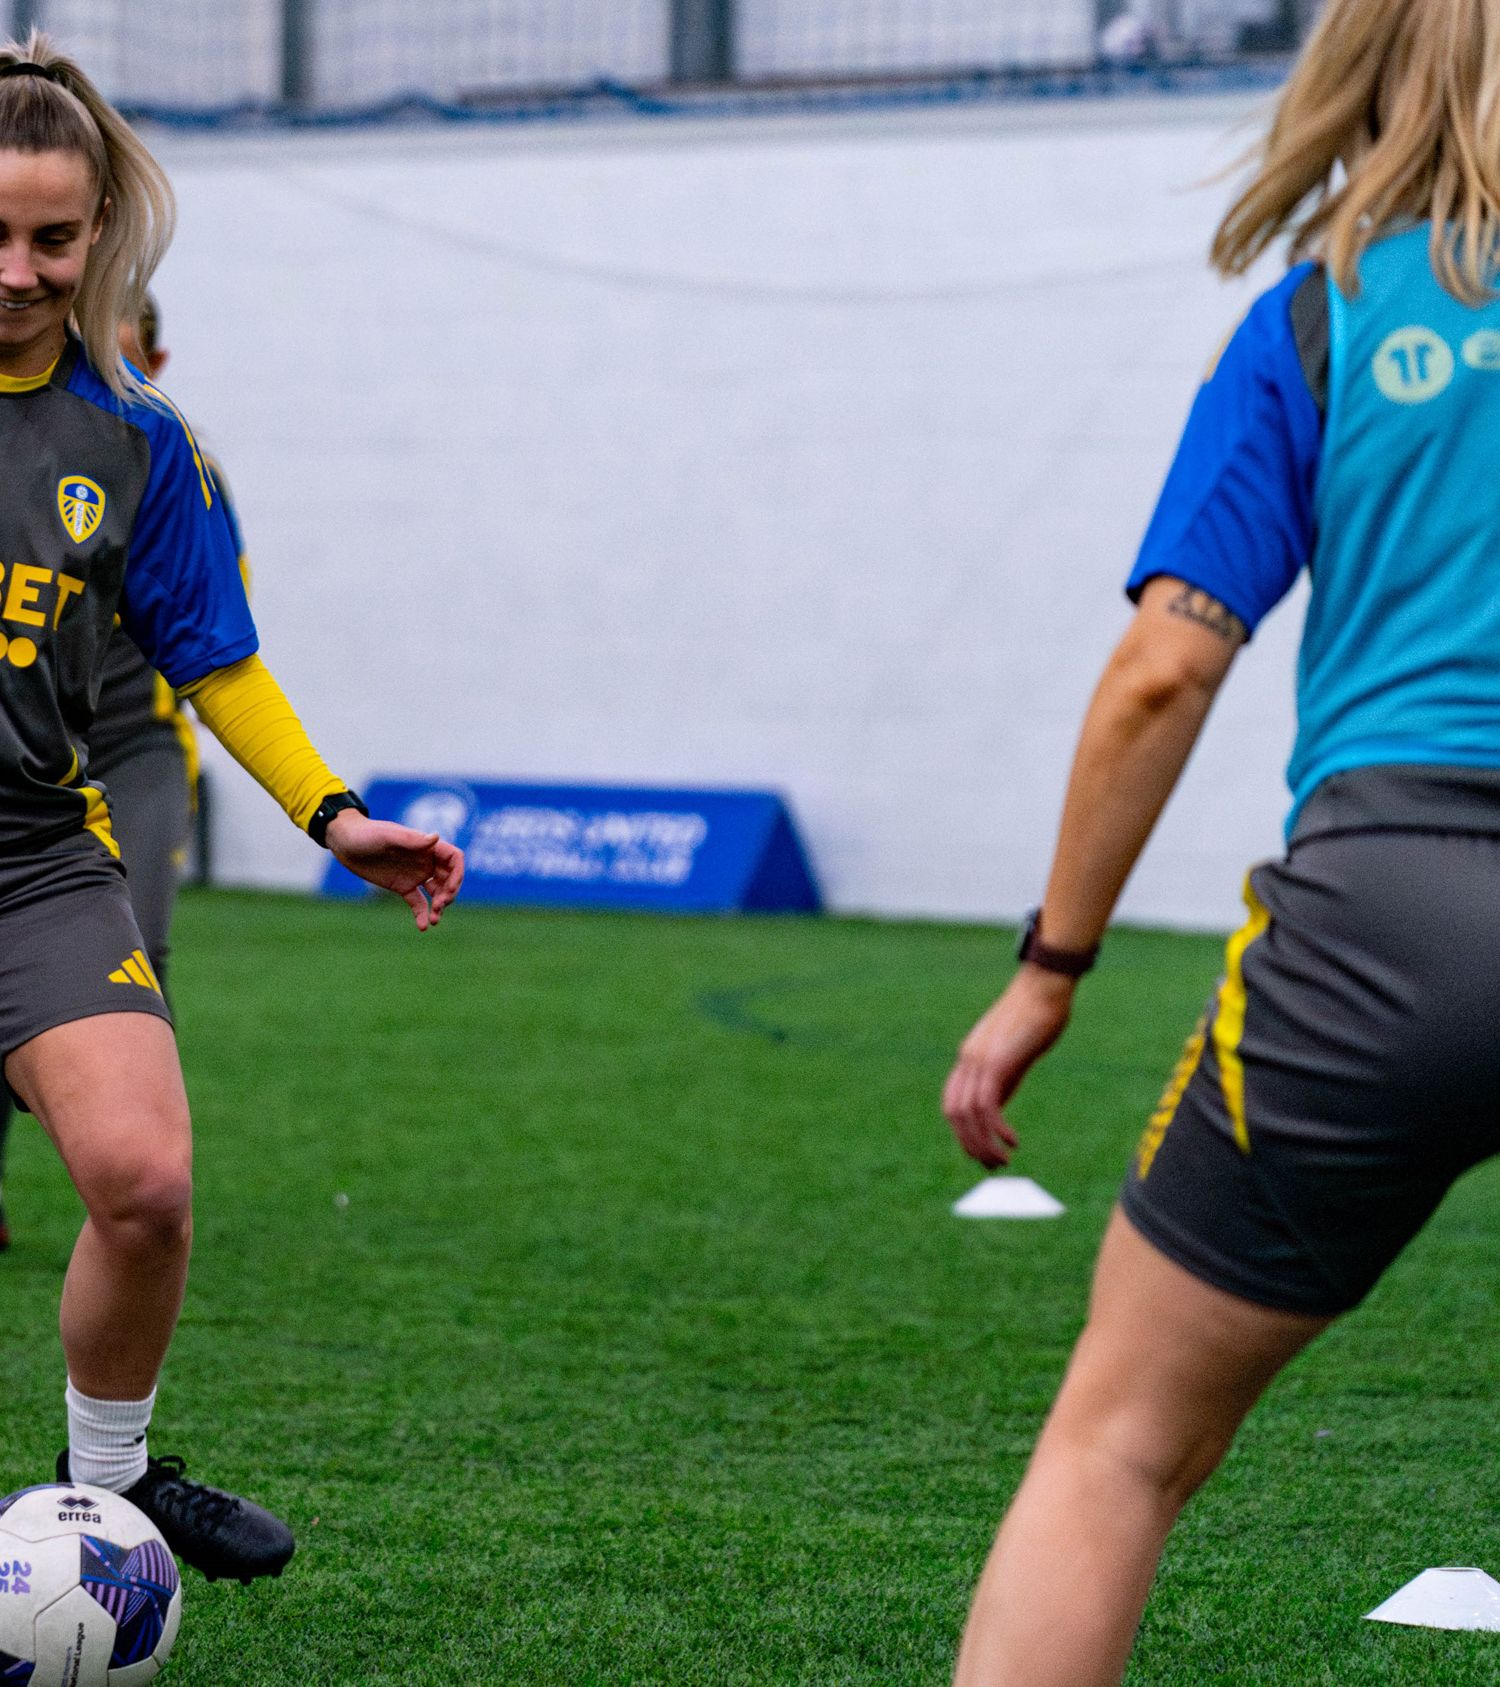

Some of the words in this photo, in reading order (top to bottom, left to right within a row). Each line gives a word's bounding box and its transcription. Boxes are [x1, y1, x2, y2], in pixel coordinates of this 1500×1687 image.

[58, 1511, 102, 1524] errea
[11, 1560, 32, 1595] 24
[73, 1622, 86, 1656] League
